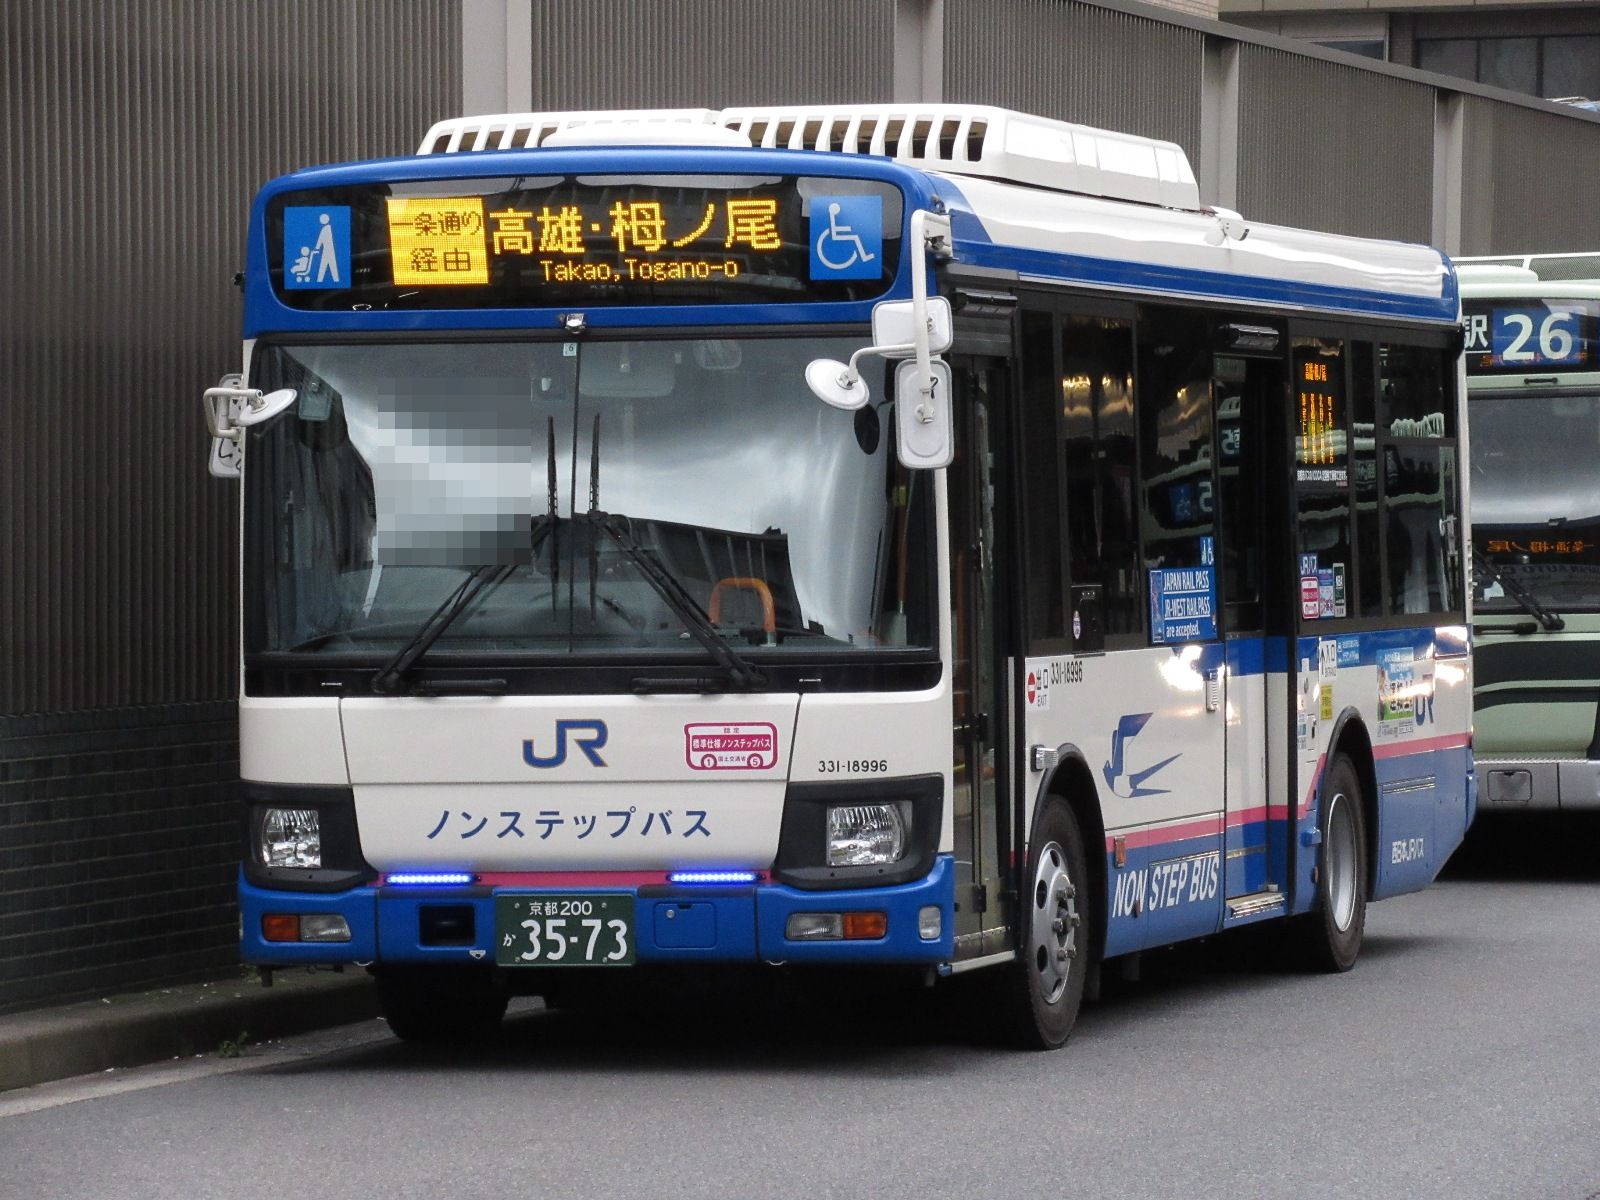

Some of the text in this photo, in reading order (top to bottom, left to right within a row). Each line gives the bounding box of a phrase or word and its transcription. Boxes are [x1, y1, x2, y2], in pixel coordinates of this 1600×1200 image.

[391, 210, 482, 236] 一条通り
[411, 247, 471, 272] 経由
[1503, 312, 1573, 361] 26
[1163, 570, 1210, 591] JAPAN RAIL PASS
[1164, 596, 1210, 617] JR-WEST RAIL PASS
[1166, 620, 1200, 639] are accepted.
[1051, 660, 1083, 685] 331-18996
[522, 718, 608, 769] JR
[692, 738, 771, 749] 標準仕様ノンステップバス
[817, 759, 888, 773] 331-18996
[426, 805, 711, 840] ノンステップバス
[1112, 854, 1220, 918] NON STEP BUS
[502, 919, 628, 961] か 35-73
